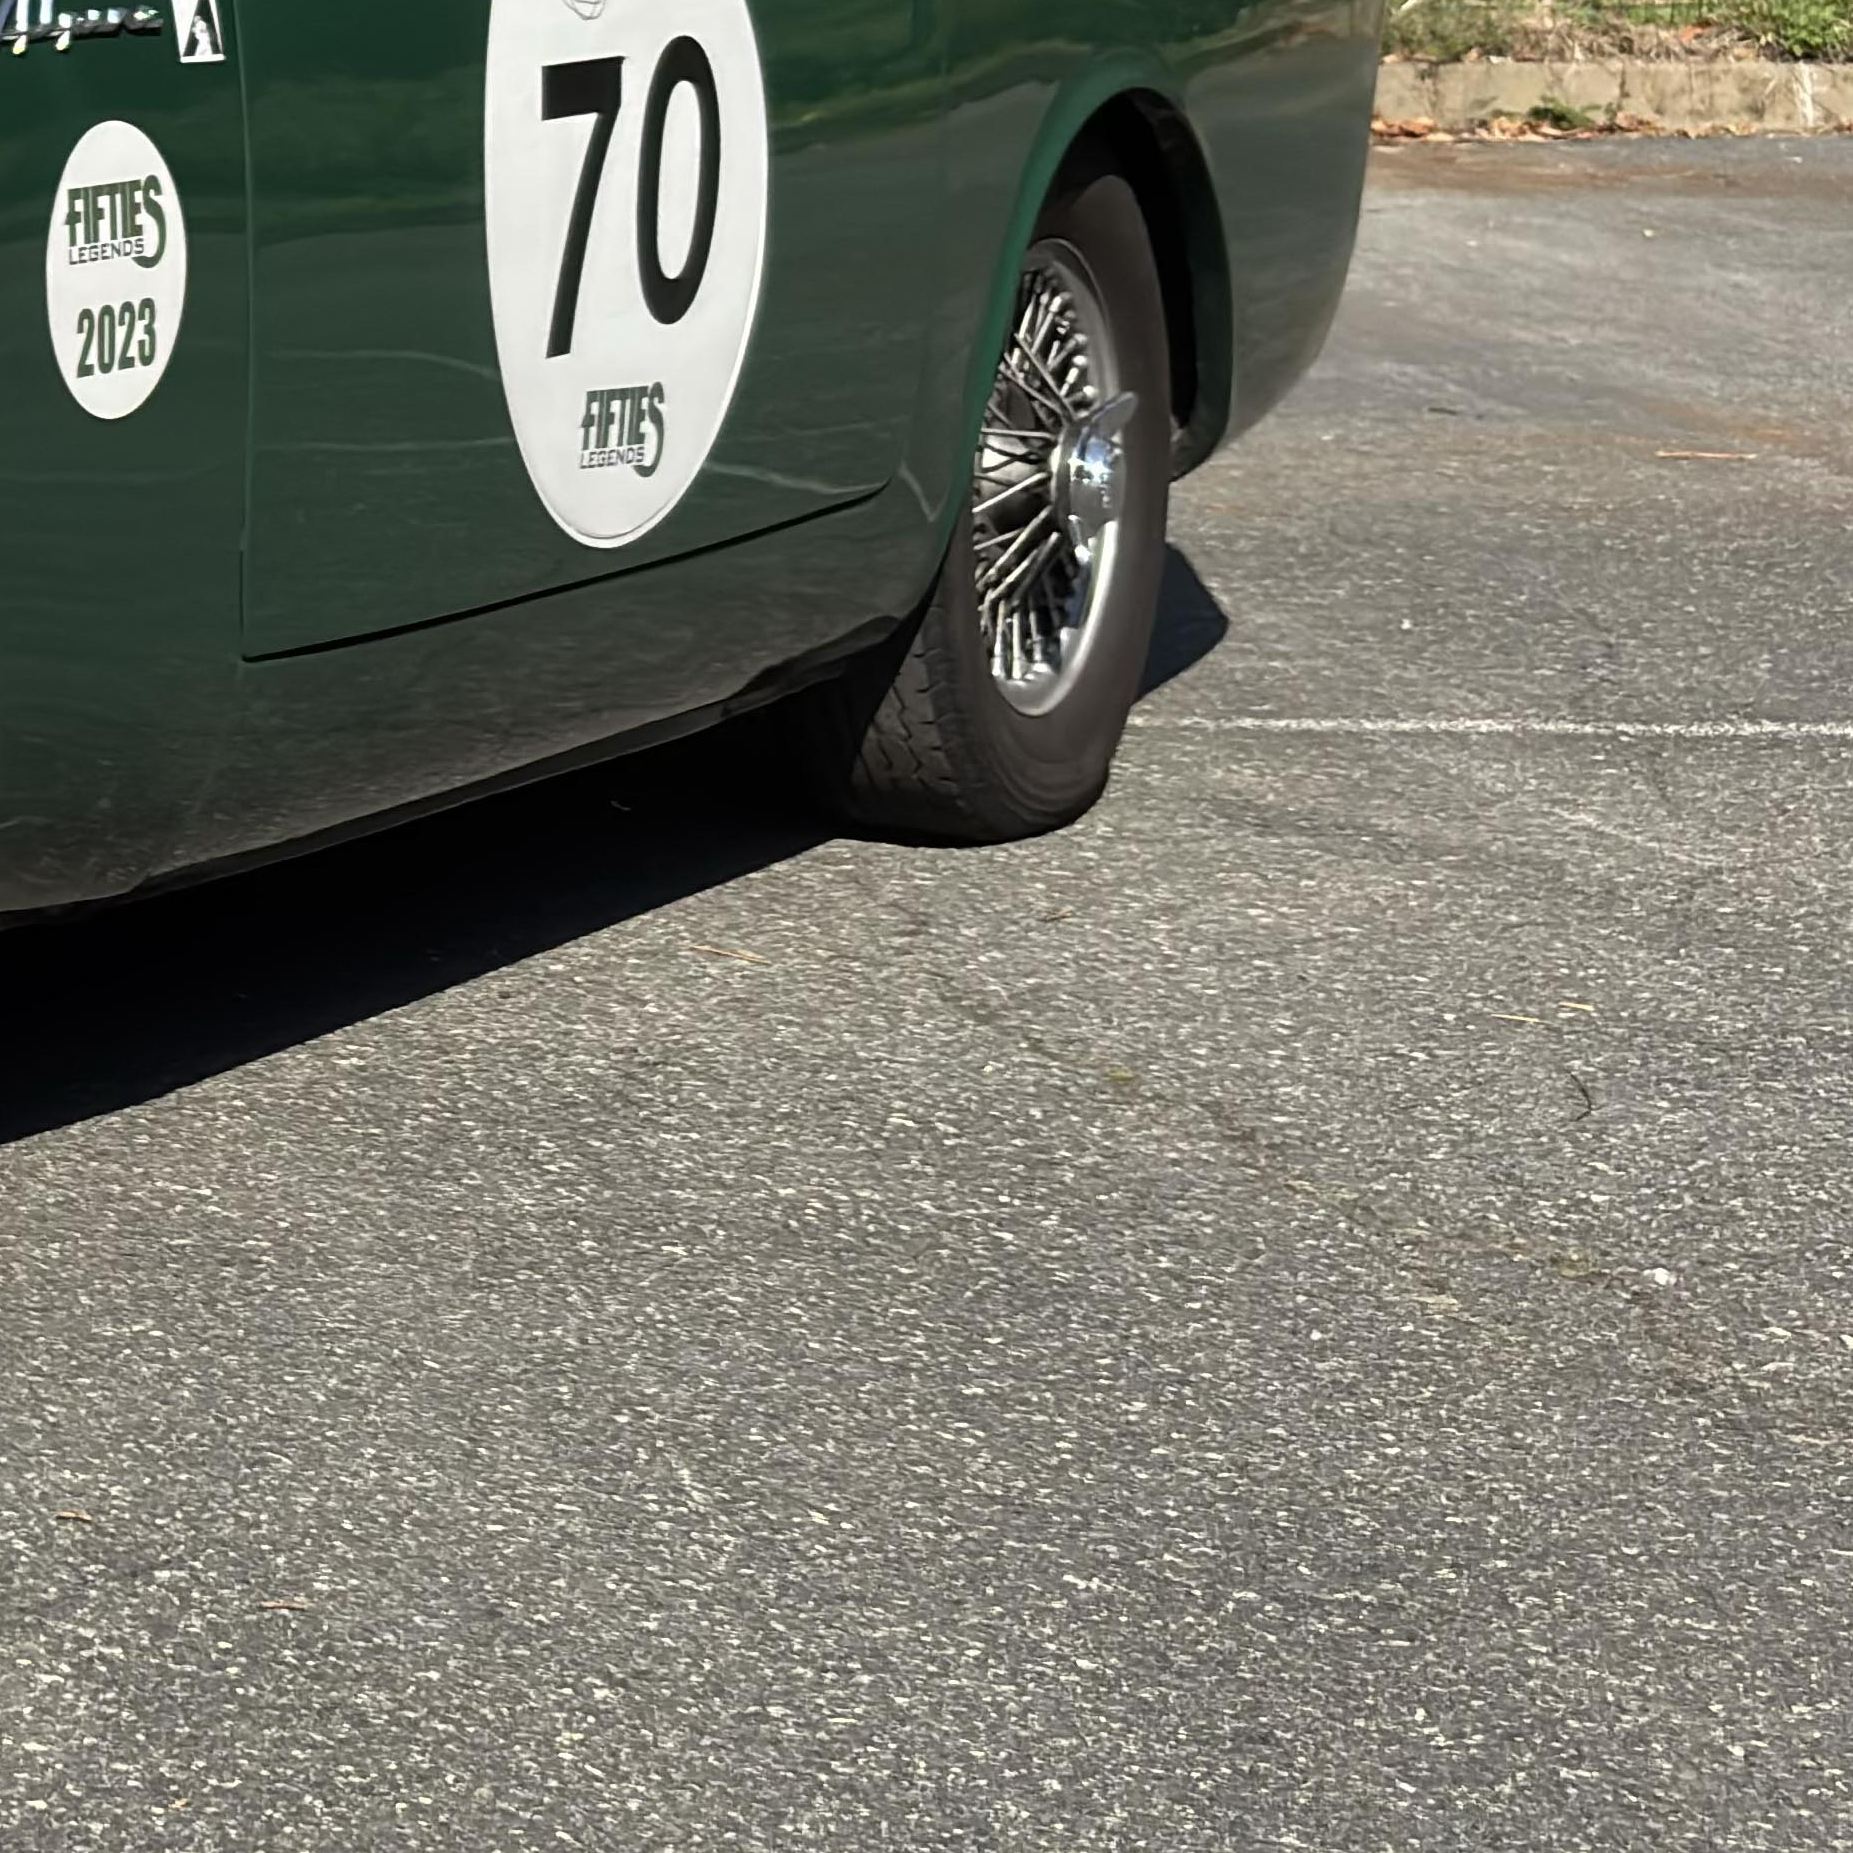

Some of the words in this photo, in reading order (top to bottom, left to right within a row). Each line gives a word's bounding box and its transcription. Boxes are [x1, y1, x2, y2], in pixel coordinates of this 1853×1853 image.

[64, 174, 168, 268] FIFTIES
[541, 35, 721, 359] 70
[69, 238, 145, 265] LEGENDS
[76, 297, 157, 378] 2023
[580, 446, 646, 469] LEGENDS
[581, 381, 665, 478] FIFTIES
